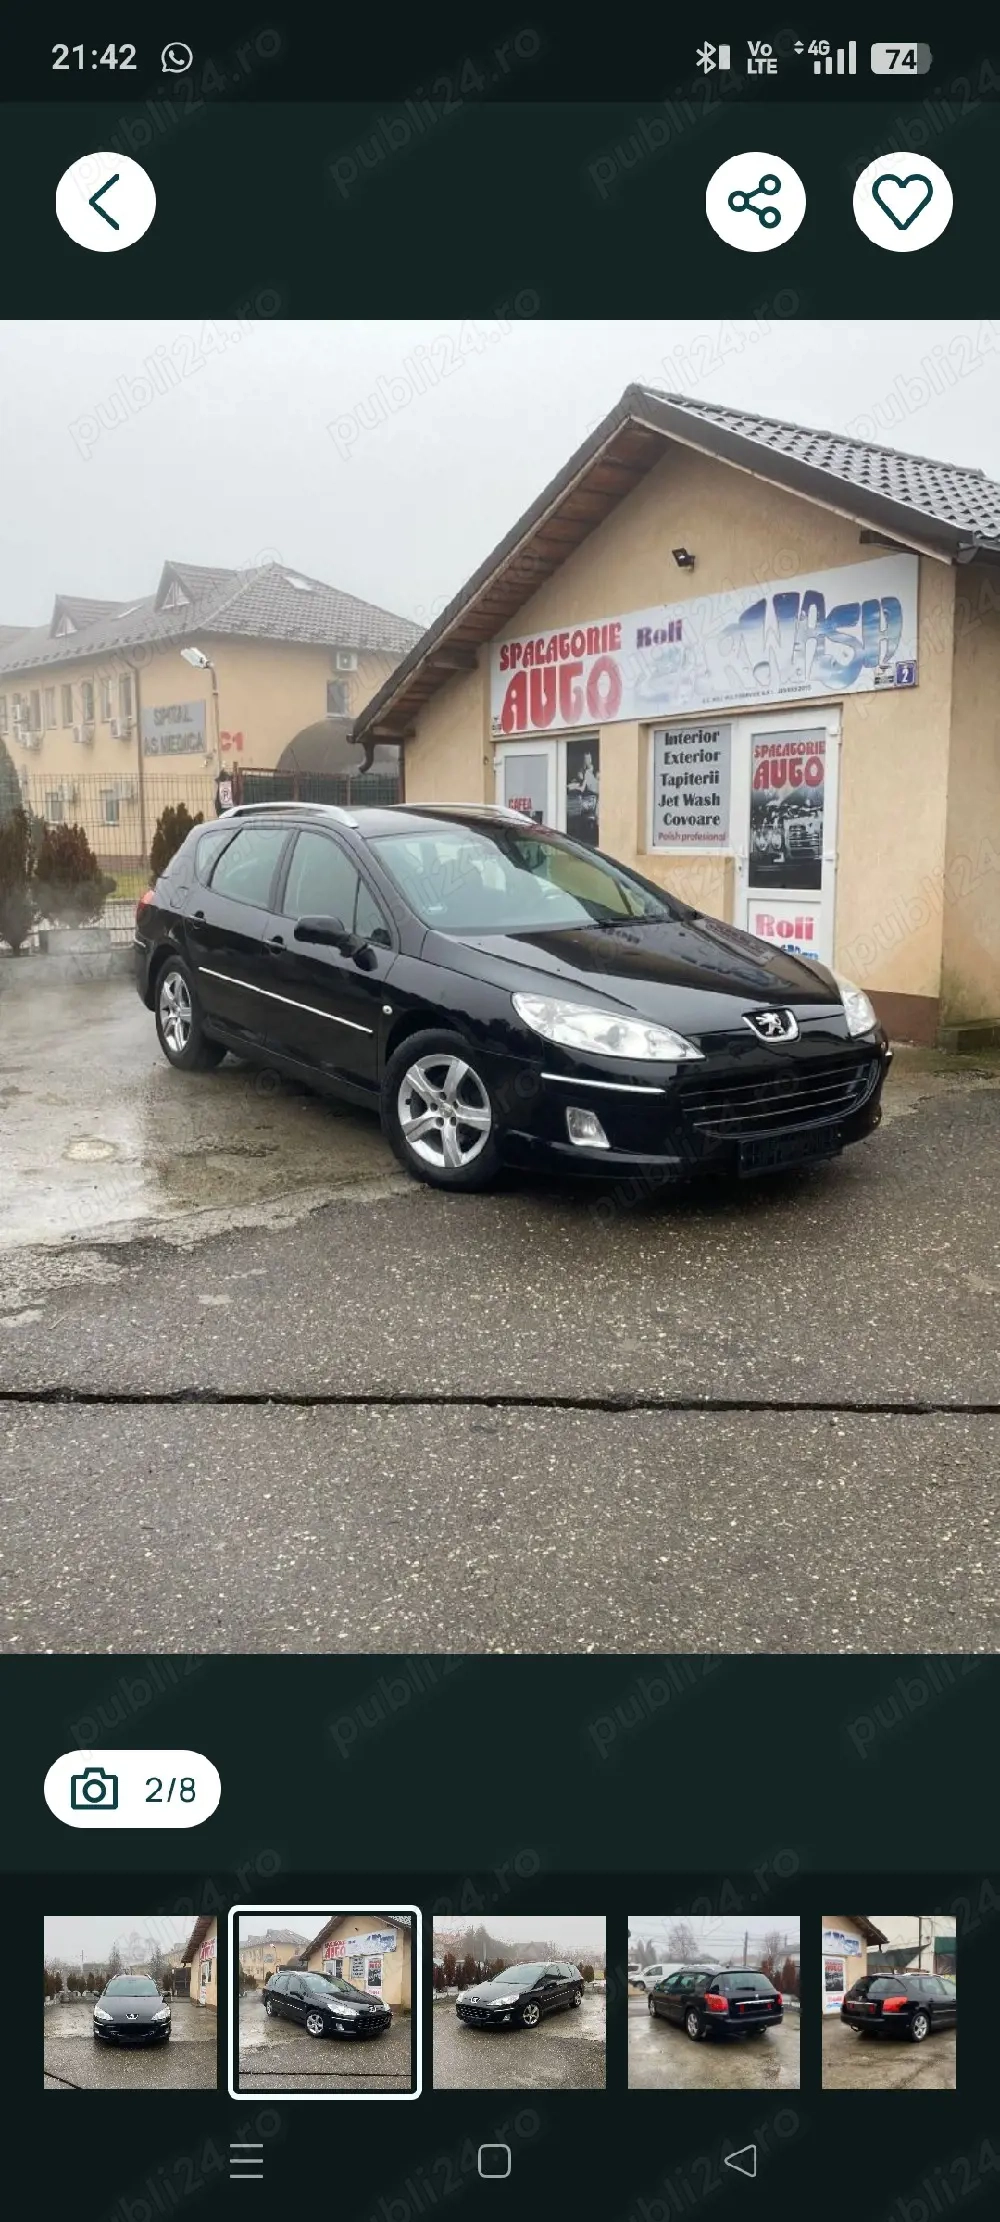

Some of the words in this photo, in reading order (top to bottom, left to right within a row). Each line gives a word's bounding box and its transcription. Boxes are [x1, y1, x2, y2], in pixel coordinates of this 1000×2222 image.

[52, 43, 137, 70] 21:42
[747, 41, 773, 57] Vo
[808, 40, 830, 56] 4G
[747, 58, 778, 75] LTE
[885, 49, 917, 70] 74
[636, 619, 683, 650] Roli
[901, 667, 910, 683] 2
[501, 655, 622, 734] AUTO
[665, 729, 720, 746] Interior
[664, 749, 721, 765] Exterior
[660, 770, 720, 788] Tapiterii
[753, 755, 825, 790] AUTO
[658, 795, 679, 807] Jet
[683, 793, 720, 806] Wash
[663, 813, 720, 826] Covoare
[755, 913, 814, 941] Roli
[145, 1777, 196, 1804] 2/8
